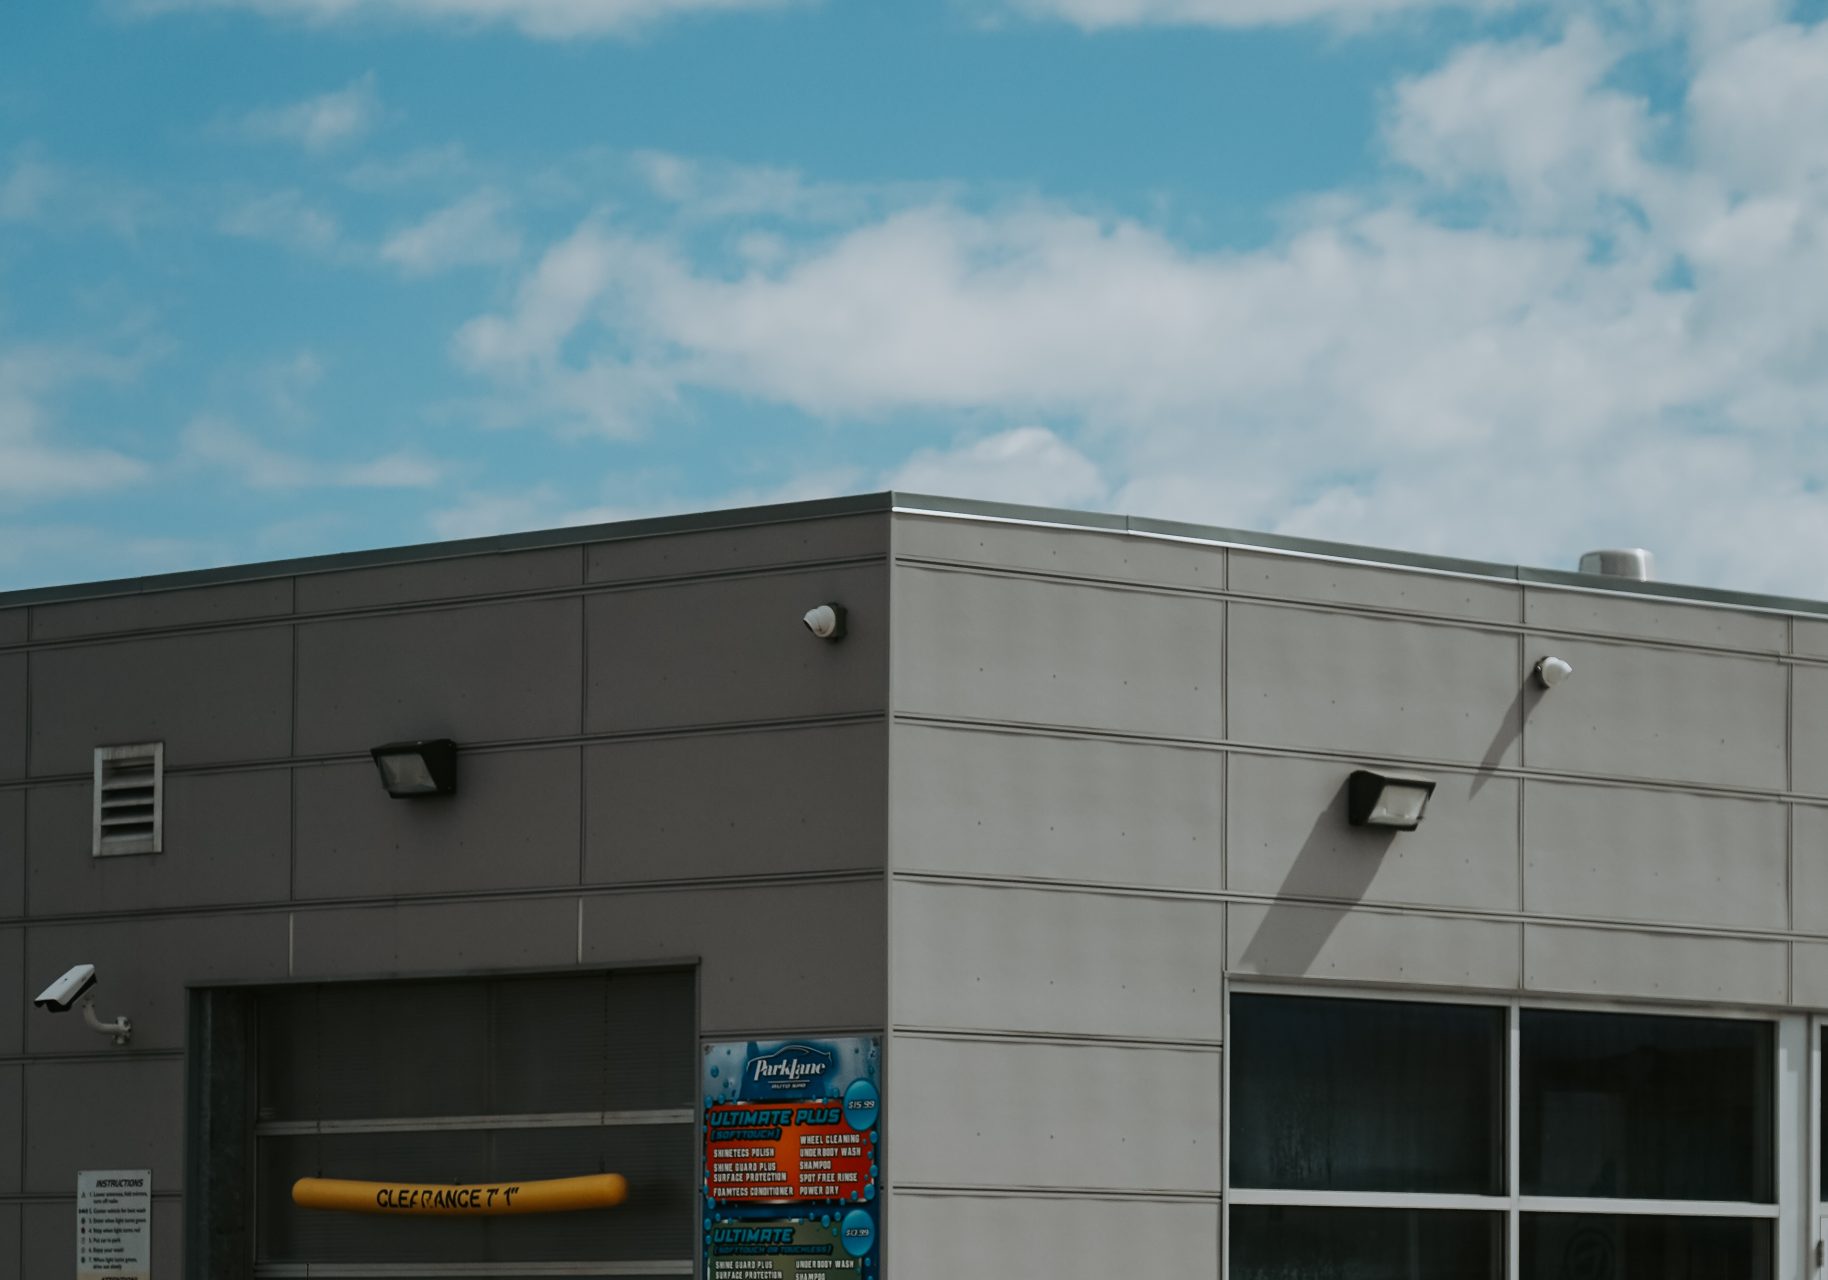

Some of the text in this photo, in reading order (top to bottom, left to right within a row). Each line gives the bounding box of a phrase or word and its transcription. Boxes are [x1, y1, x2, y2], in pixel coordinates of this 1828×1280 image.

[848, 1100, 875, 1109] $15.99
[711, 1108, 841, 1127] ULTIMATE PLUS
[800, 1134, 860, 1144] WHEEL CLEANING
[713, 1148, 775, 1158] SHINETECS POLISH
[800, 1147, 861, 1157] UNDERBODY WASH
[713, 1162, 776, 1172] SHINE GUARD PLUS
[800, 1160, 831, 1170] SHAMPOO
[713, 1172, 787, 1182] SURFACE PROTECTION
[800, 1172, 858, 1182] SPOT FREE RINSE
[96, 1179, 144, 1188] INSTRUCTIONS
[713, 1186, 794, 1197] FOAMTECS CONDITIONER
[800, 1186, 839, 1195] POWER DRY
[713, 1228, 793, 1243] ULTIMATE
[715, 1261, 773, 1269] SHINE GUARD PLUS
[795, 1260, 854, 1269] UNDERBODY WASH
[715, 1271, 783, 1280] SURFACE PROTECTION
